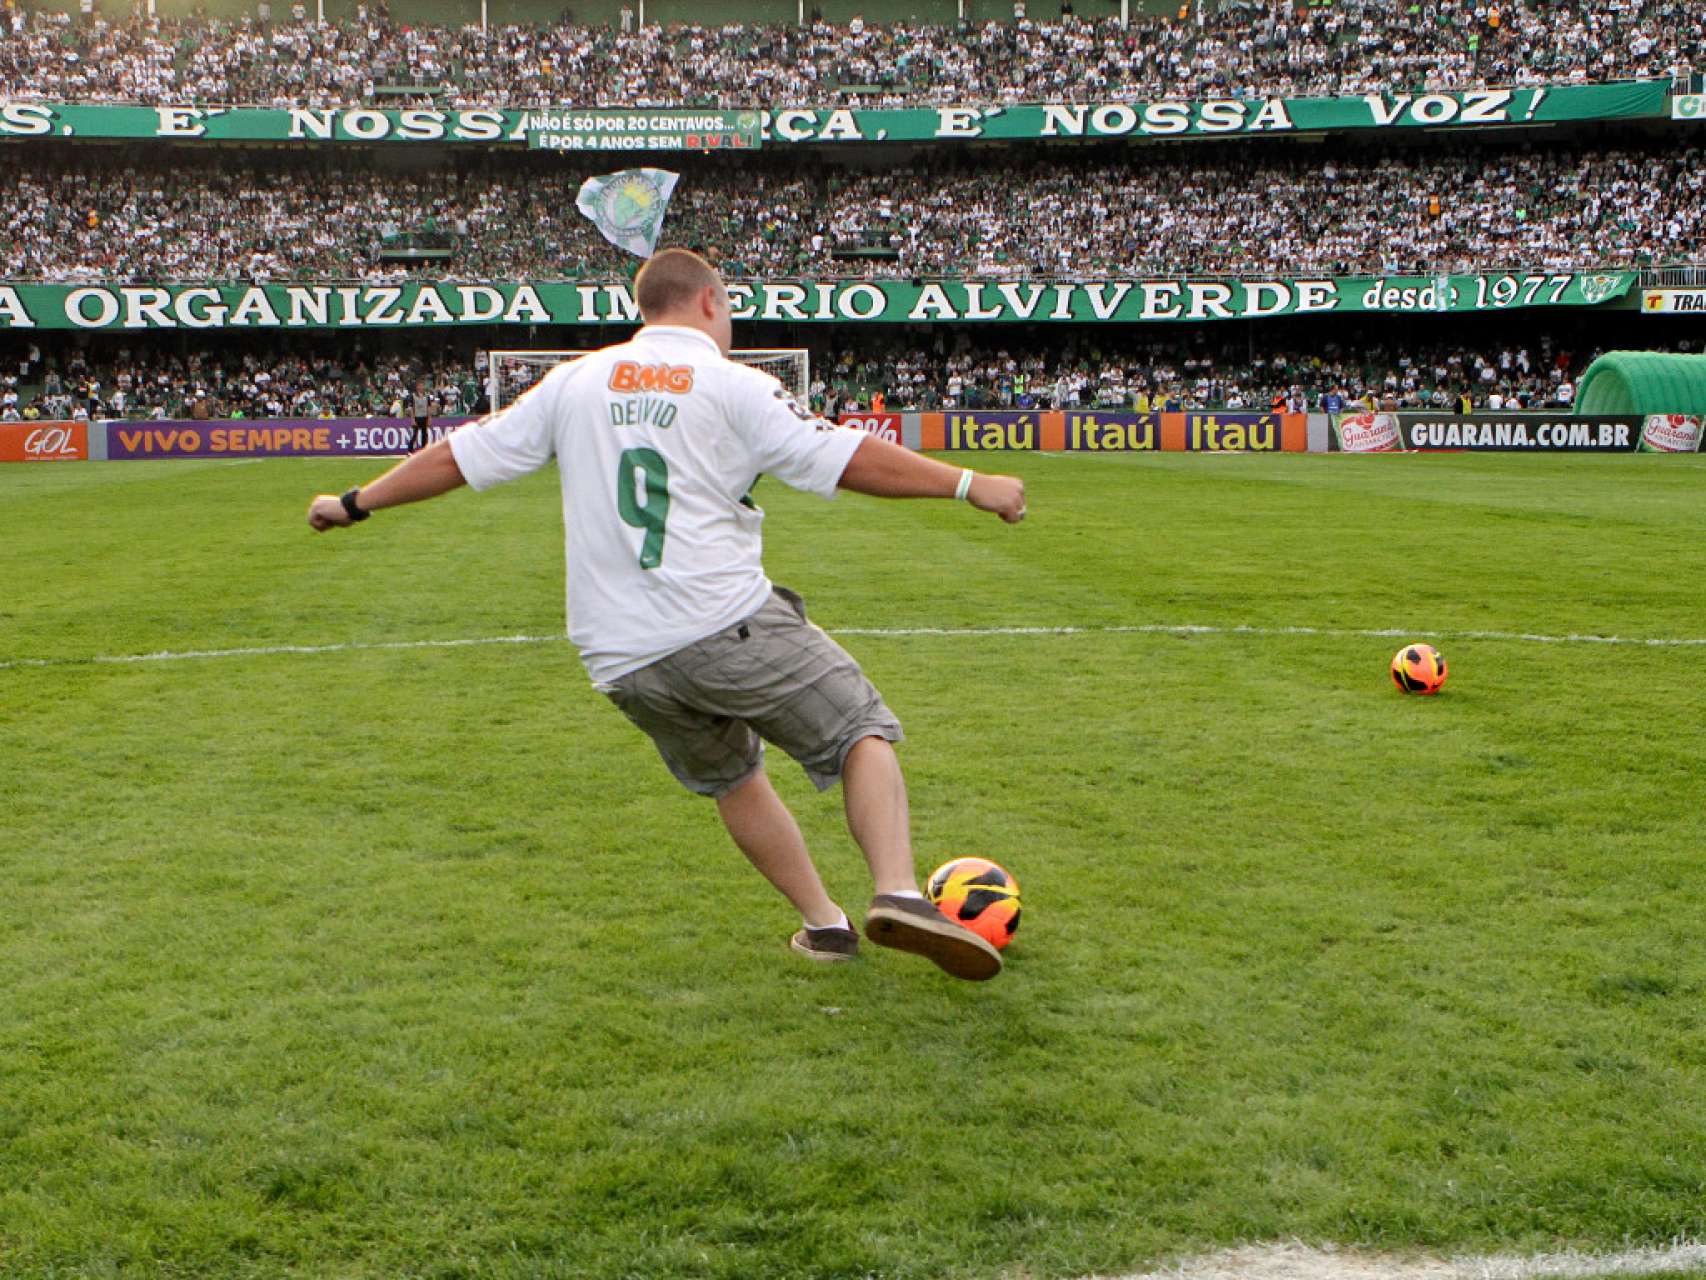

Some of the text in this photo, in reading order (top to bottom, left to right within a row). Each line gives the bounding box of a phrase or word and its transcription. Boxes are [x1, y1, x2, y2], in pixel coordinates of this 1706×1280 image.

[288, 107, 528, 140] NOSS
[1041, 99, 1293, 136] NOSSA
[530, 112, 560, 131] NÃO
[573, 113, 594, 130] SÓ
[596, 115, 626, 131] POR
[627, 115, 648, 131] 20
[549, 134, 584, 149] POR
[586, 134, 597, 148] 4
[598, 134, 646, 149] ANOS
[647, 135, 683, 149] SEM
[64, 285, 550, 329] ORGANIZADA
[577, 284, 887, 322] IMERIO
[908, 281, 1339, 322] ALVIVERDE
[1474, 275, 1572, 309] 1977
[1673, 294, 1706, 311] TRA
[608, 361, 695, 394] BMG
[25, 428, 78, 454] GOL
[118, 429, 200, 452] VIVO
[210, 428, 331, 451] SEMPRE
[951, 416, 1034, 450] Itaú
[1072, 416, 1154, 450] Itaú
[1192, 416, 1274, 449] Itaú
[1411, 423, 1629, 446] GUARANA.COM.BR
[618, 447, 670, 569] 9
